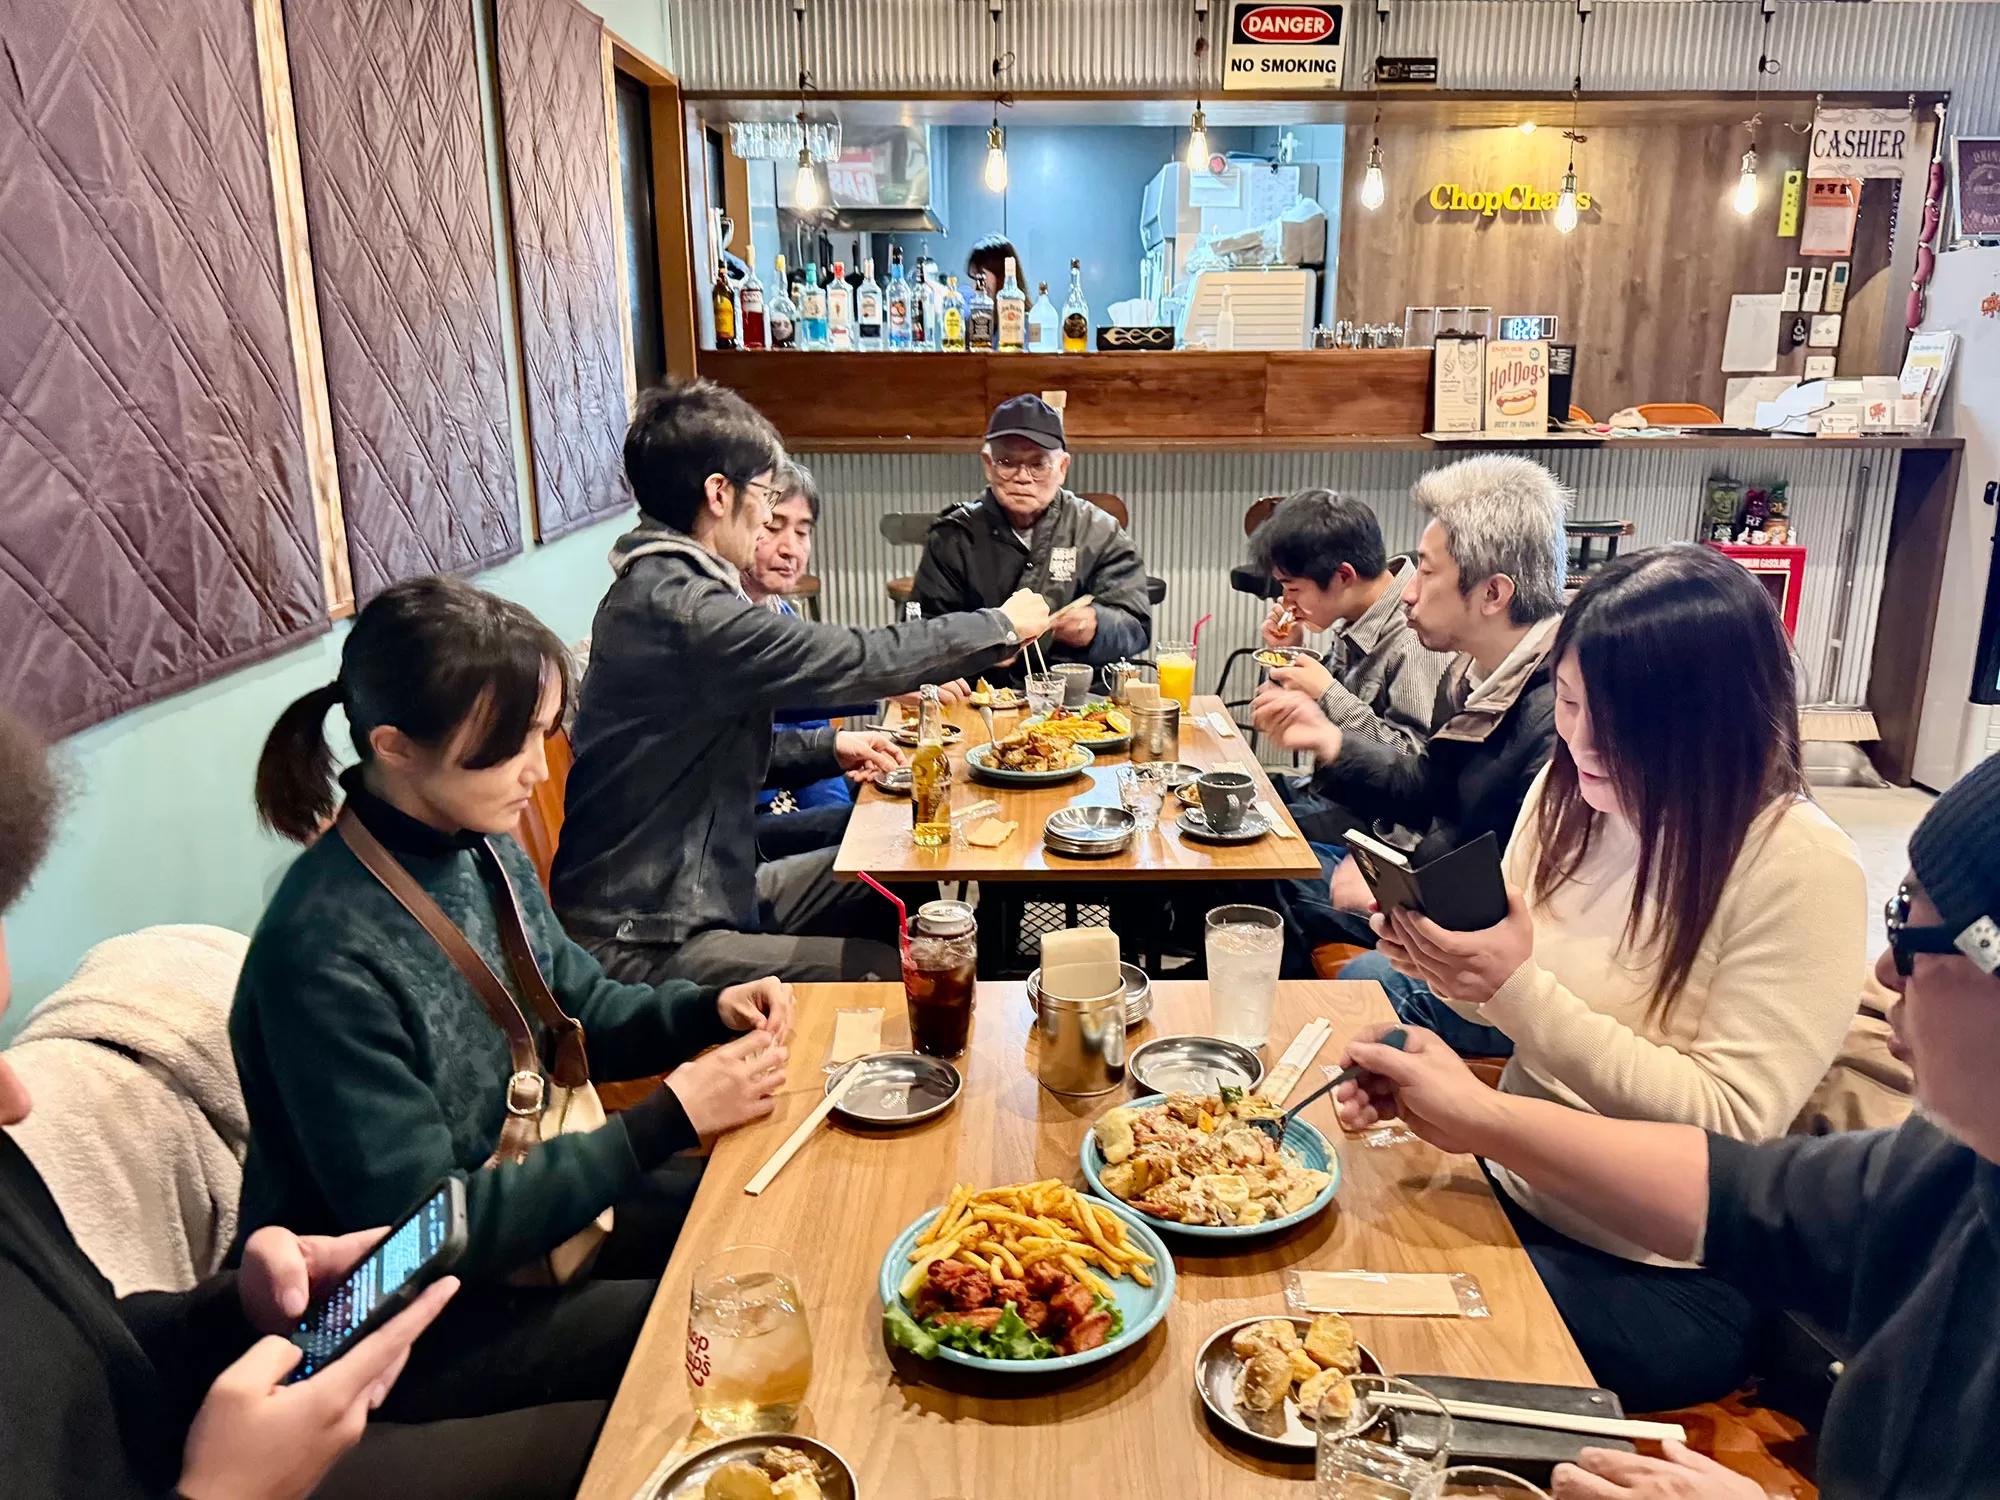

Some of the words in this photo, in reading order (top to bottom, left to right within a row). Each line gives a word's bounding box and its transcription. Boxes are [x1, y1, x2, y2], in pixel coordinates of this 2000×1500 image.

[1248, 16, 1325, 34] DANGER
[1231, 59, 1254, 73] NO
[1260, 59, 1337, 73] SMOKING
[1813, 129, 1906, 160] CASHIER
[1429, 184, 1592, 217] ChopChas
[1513, 361, 1546, 387] Dogs
